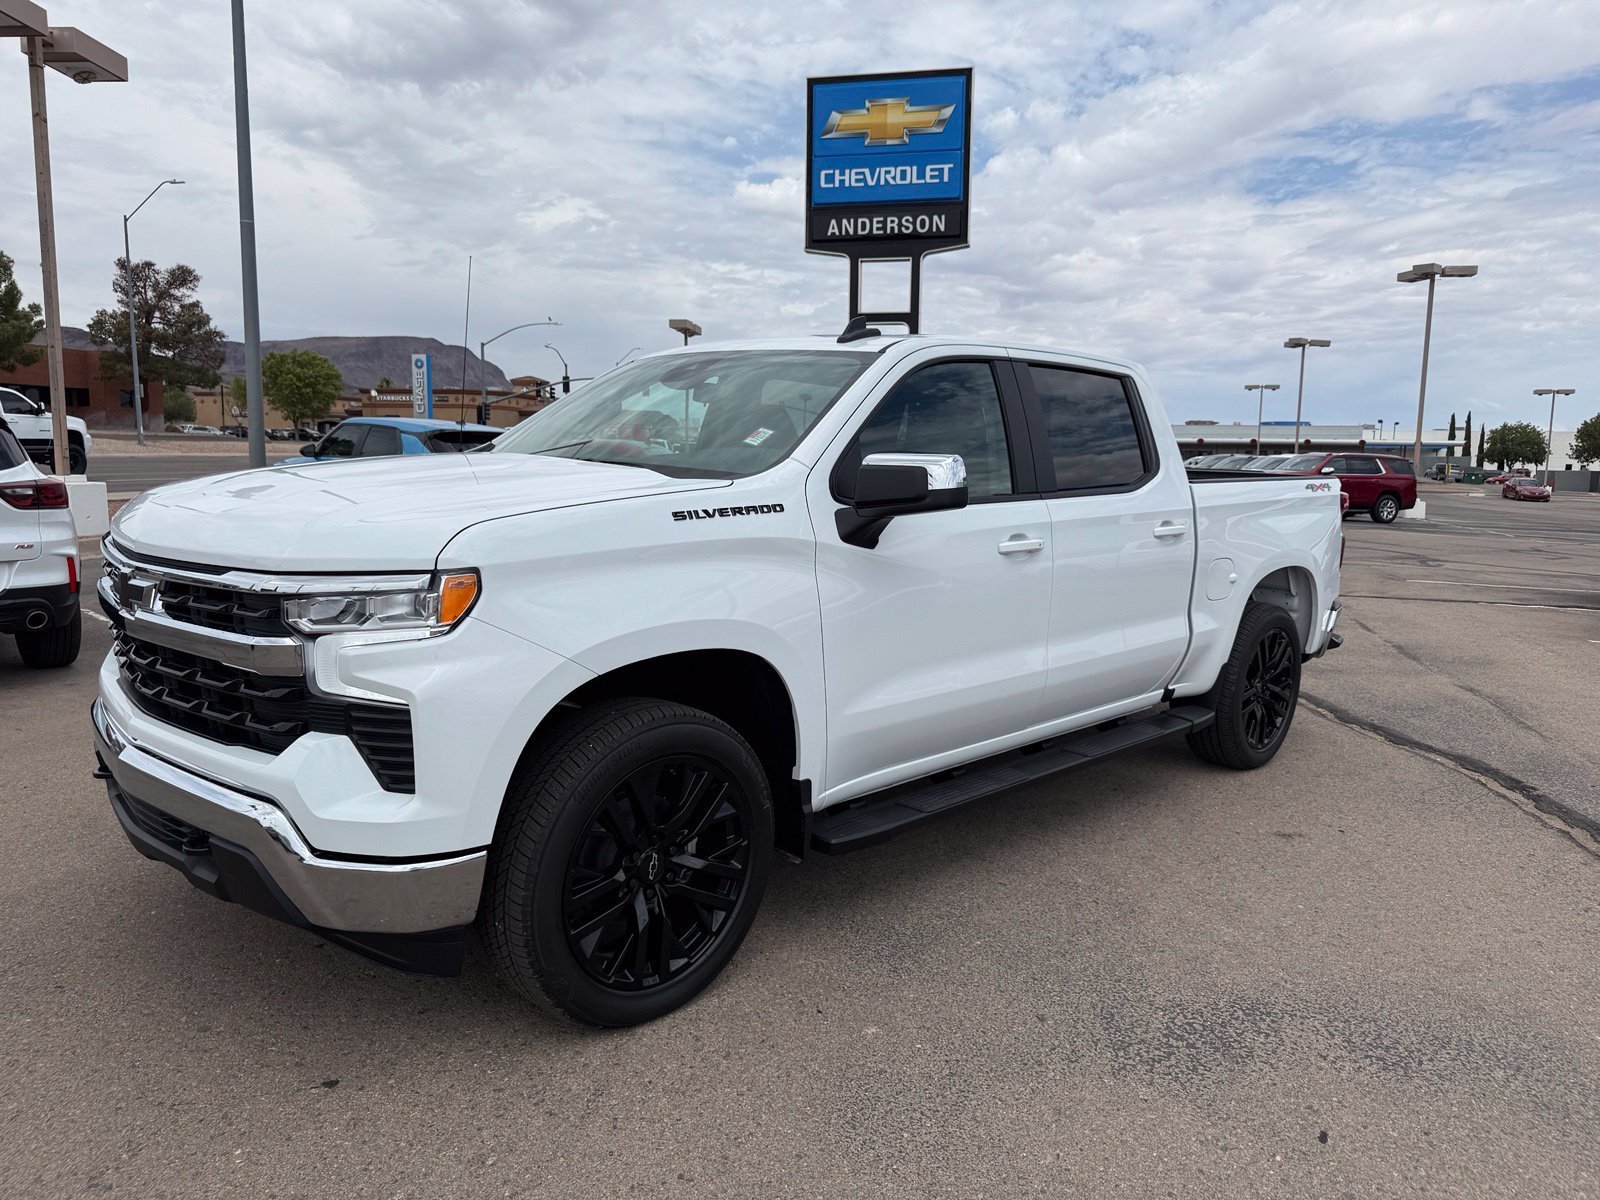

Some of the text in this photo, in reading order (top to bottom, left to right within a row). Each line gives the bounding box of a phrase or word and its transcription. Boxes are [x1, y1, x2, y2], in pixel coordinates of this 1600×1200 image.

[820, 164, 954, 188] CHEVROLET
[827, 214, 946, 236] ANDERSON
[416, 370, 425, 413] CHASE
[672, 503, 785, 521] SILVERADO
